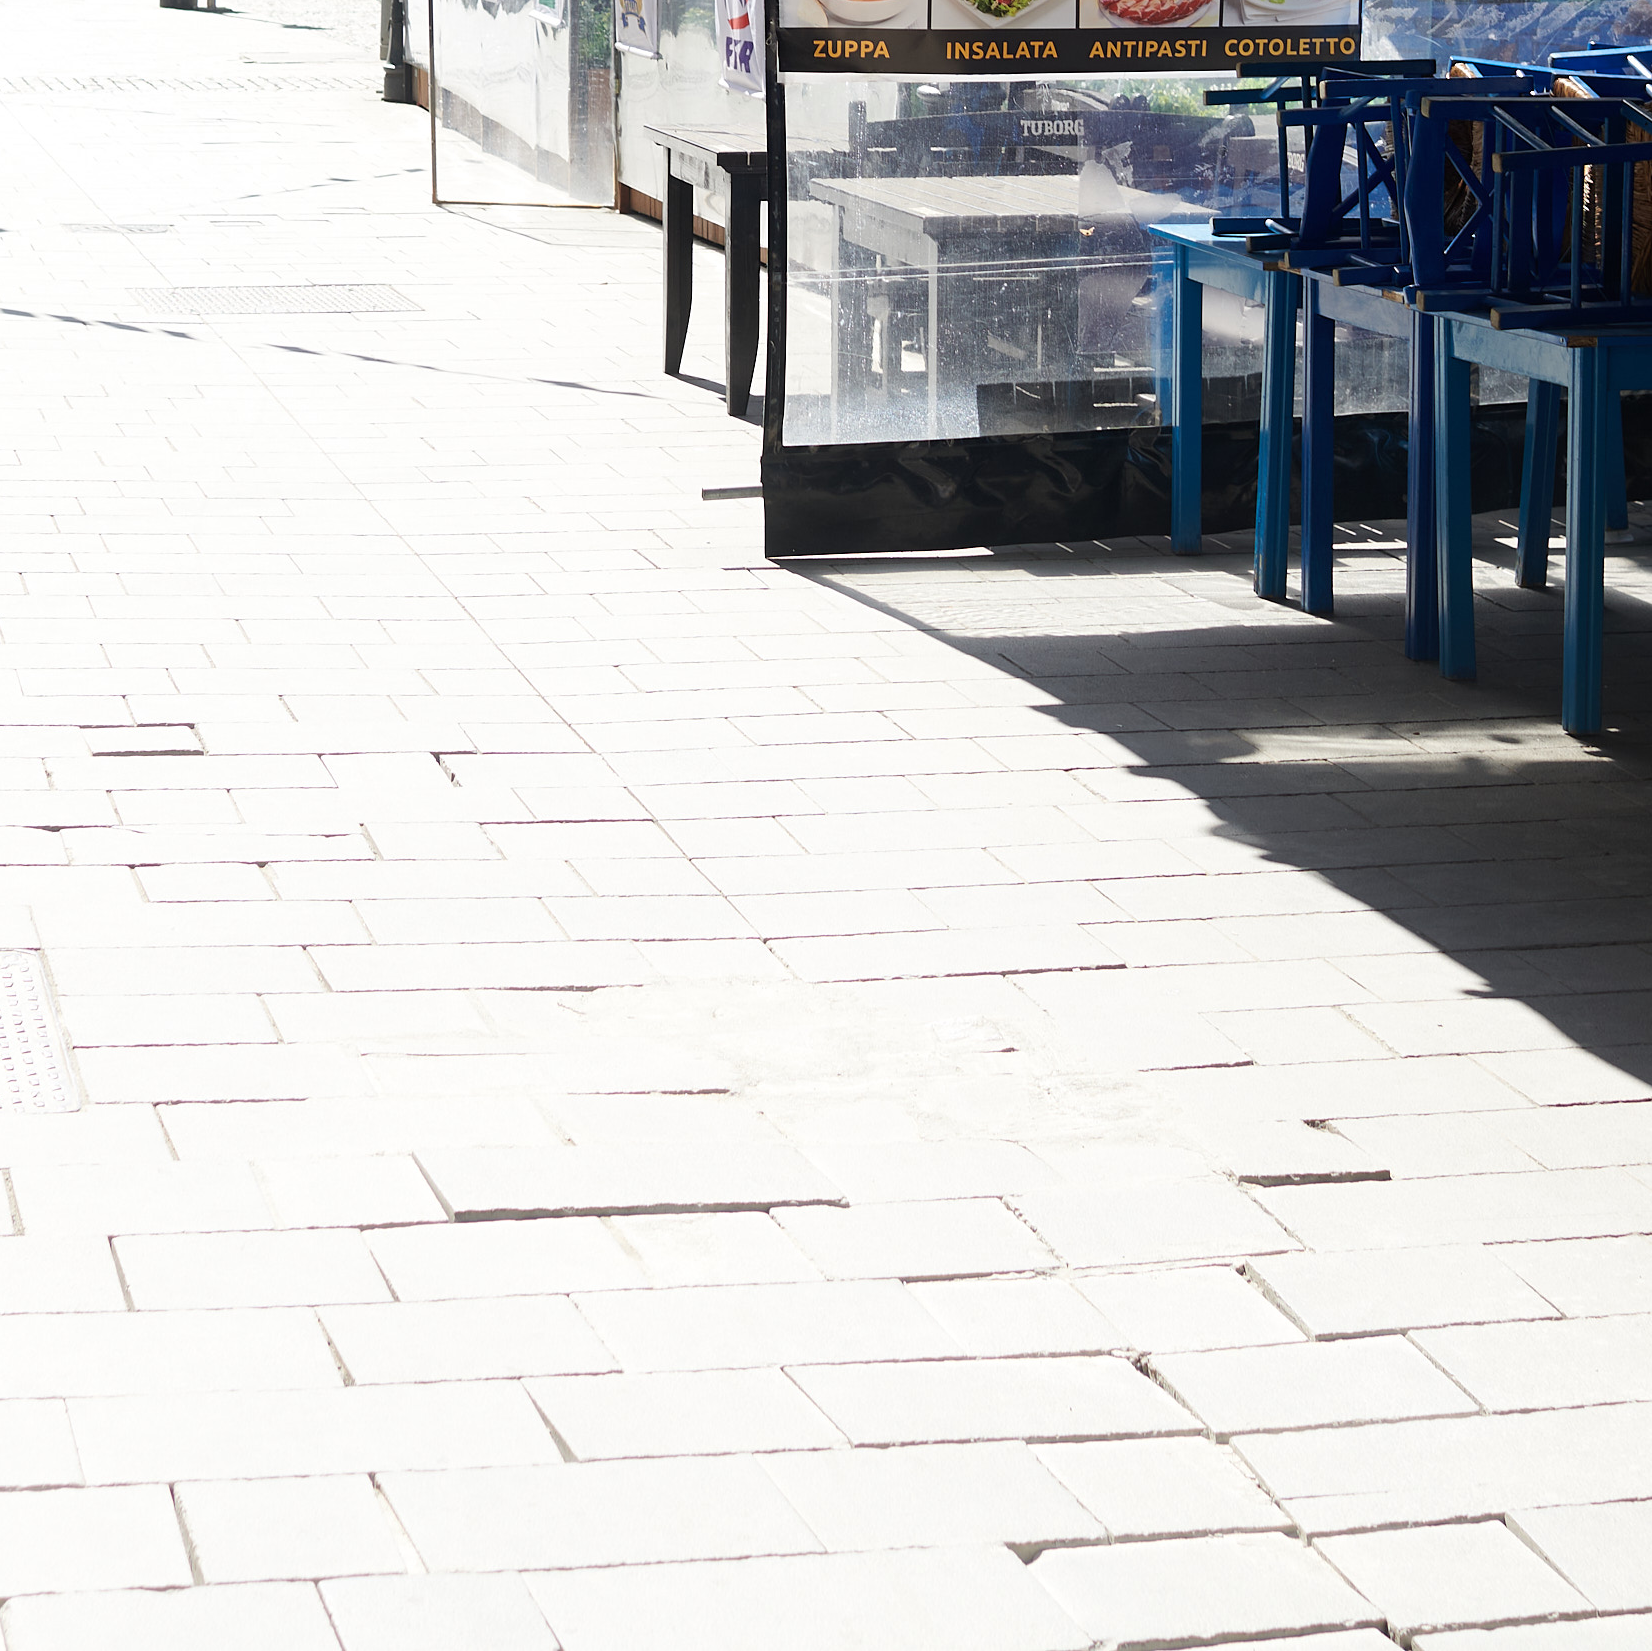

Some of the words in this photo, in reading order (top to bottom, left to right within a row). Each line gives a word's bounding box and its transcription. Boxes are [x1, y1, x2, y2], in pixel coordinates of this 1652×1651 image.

[812, 39, 891, 59] ZUPPA
[946, 40, 1059, 60] INSALATA
[1089, 39, 1209, 59] ANTIPASTI
[1224, 36, 1356, 57] COTOLETTO
[1020, 118, 1085, 137] TUBORG
[1287, 151, 1306, 173] BORG
